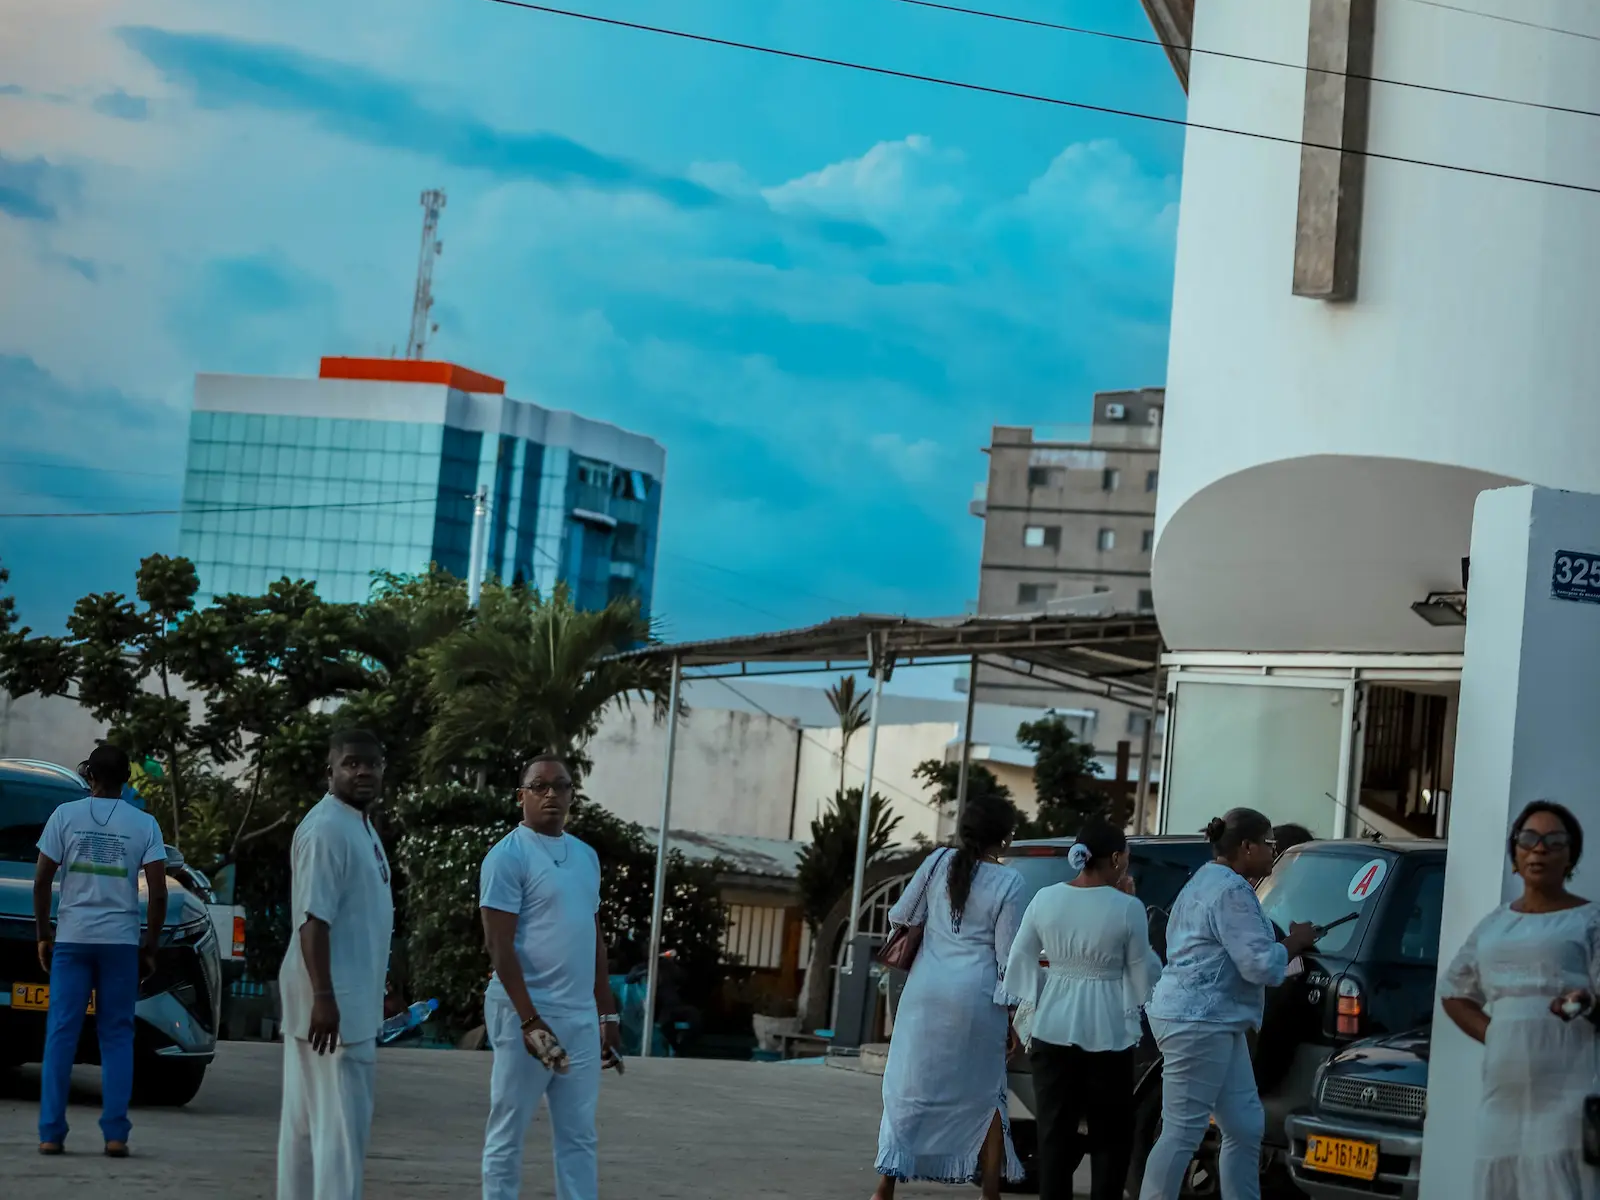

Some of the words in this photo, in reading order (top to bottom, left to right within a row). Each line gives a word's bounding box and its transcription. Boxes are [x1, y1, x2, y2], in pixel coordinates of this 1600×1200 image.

[1556, 556, 1600, 587] 325
[1352, 864, 1379, 896] A
[1314, 1140, 1370, 1170] CJ-161-AA
